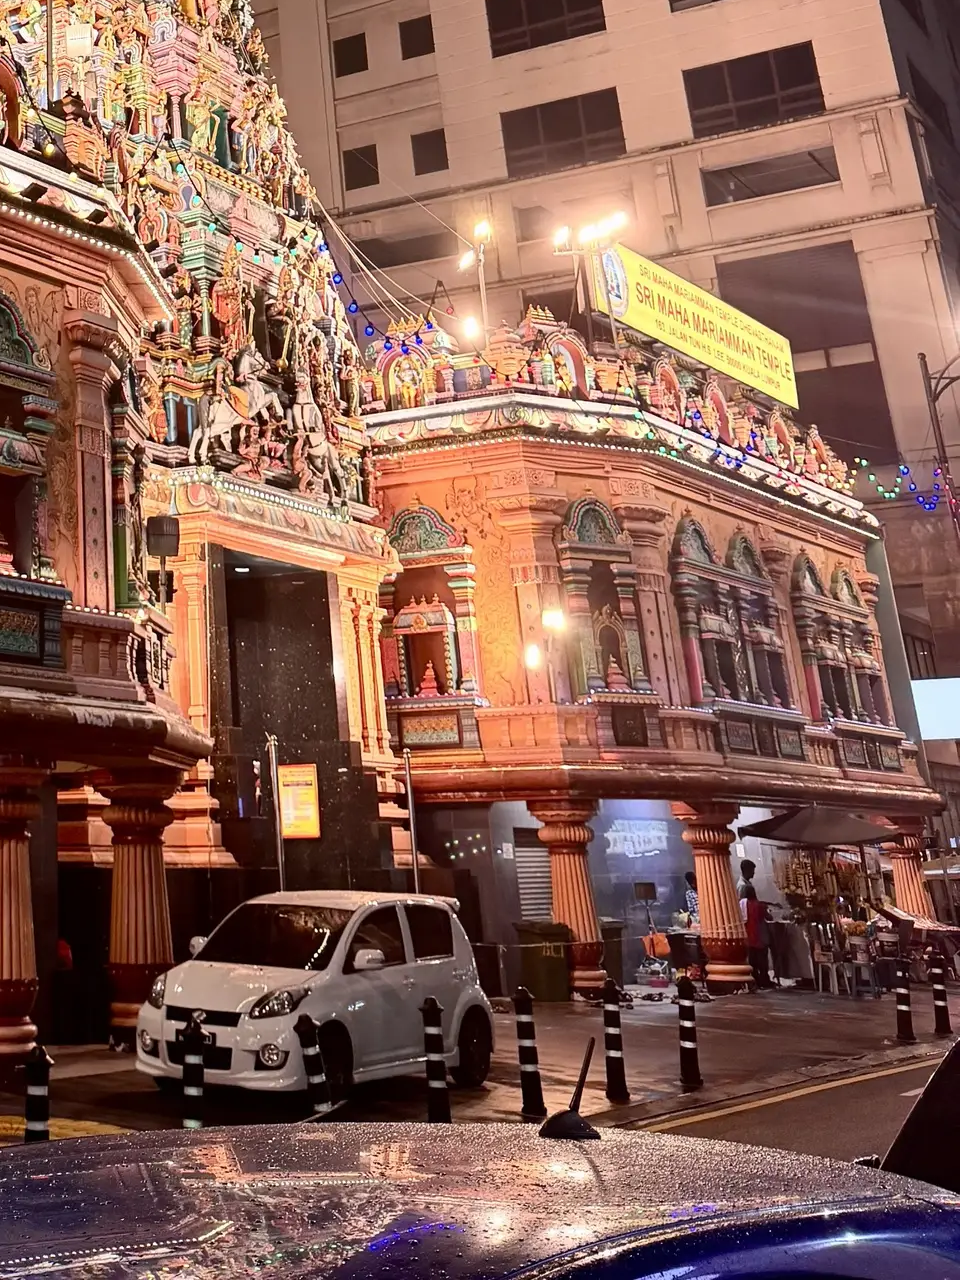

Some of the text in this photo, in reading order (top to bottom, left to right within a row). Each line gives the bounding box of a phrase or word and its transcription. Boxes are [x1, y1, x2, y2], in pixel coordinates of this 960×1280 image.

[635, 281, 792, 382] SRI MAHA MARIAMMAN TEMPLE
[639, 264, 651, 280] SRI
[652, 272, 673, 292] MAHA
[674, 284, 714, 313] MARIAMMAN
[715, 306, 738, 328] TEMPLE
